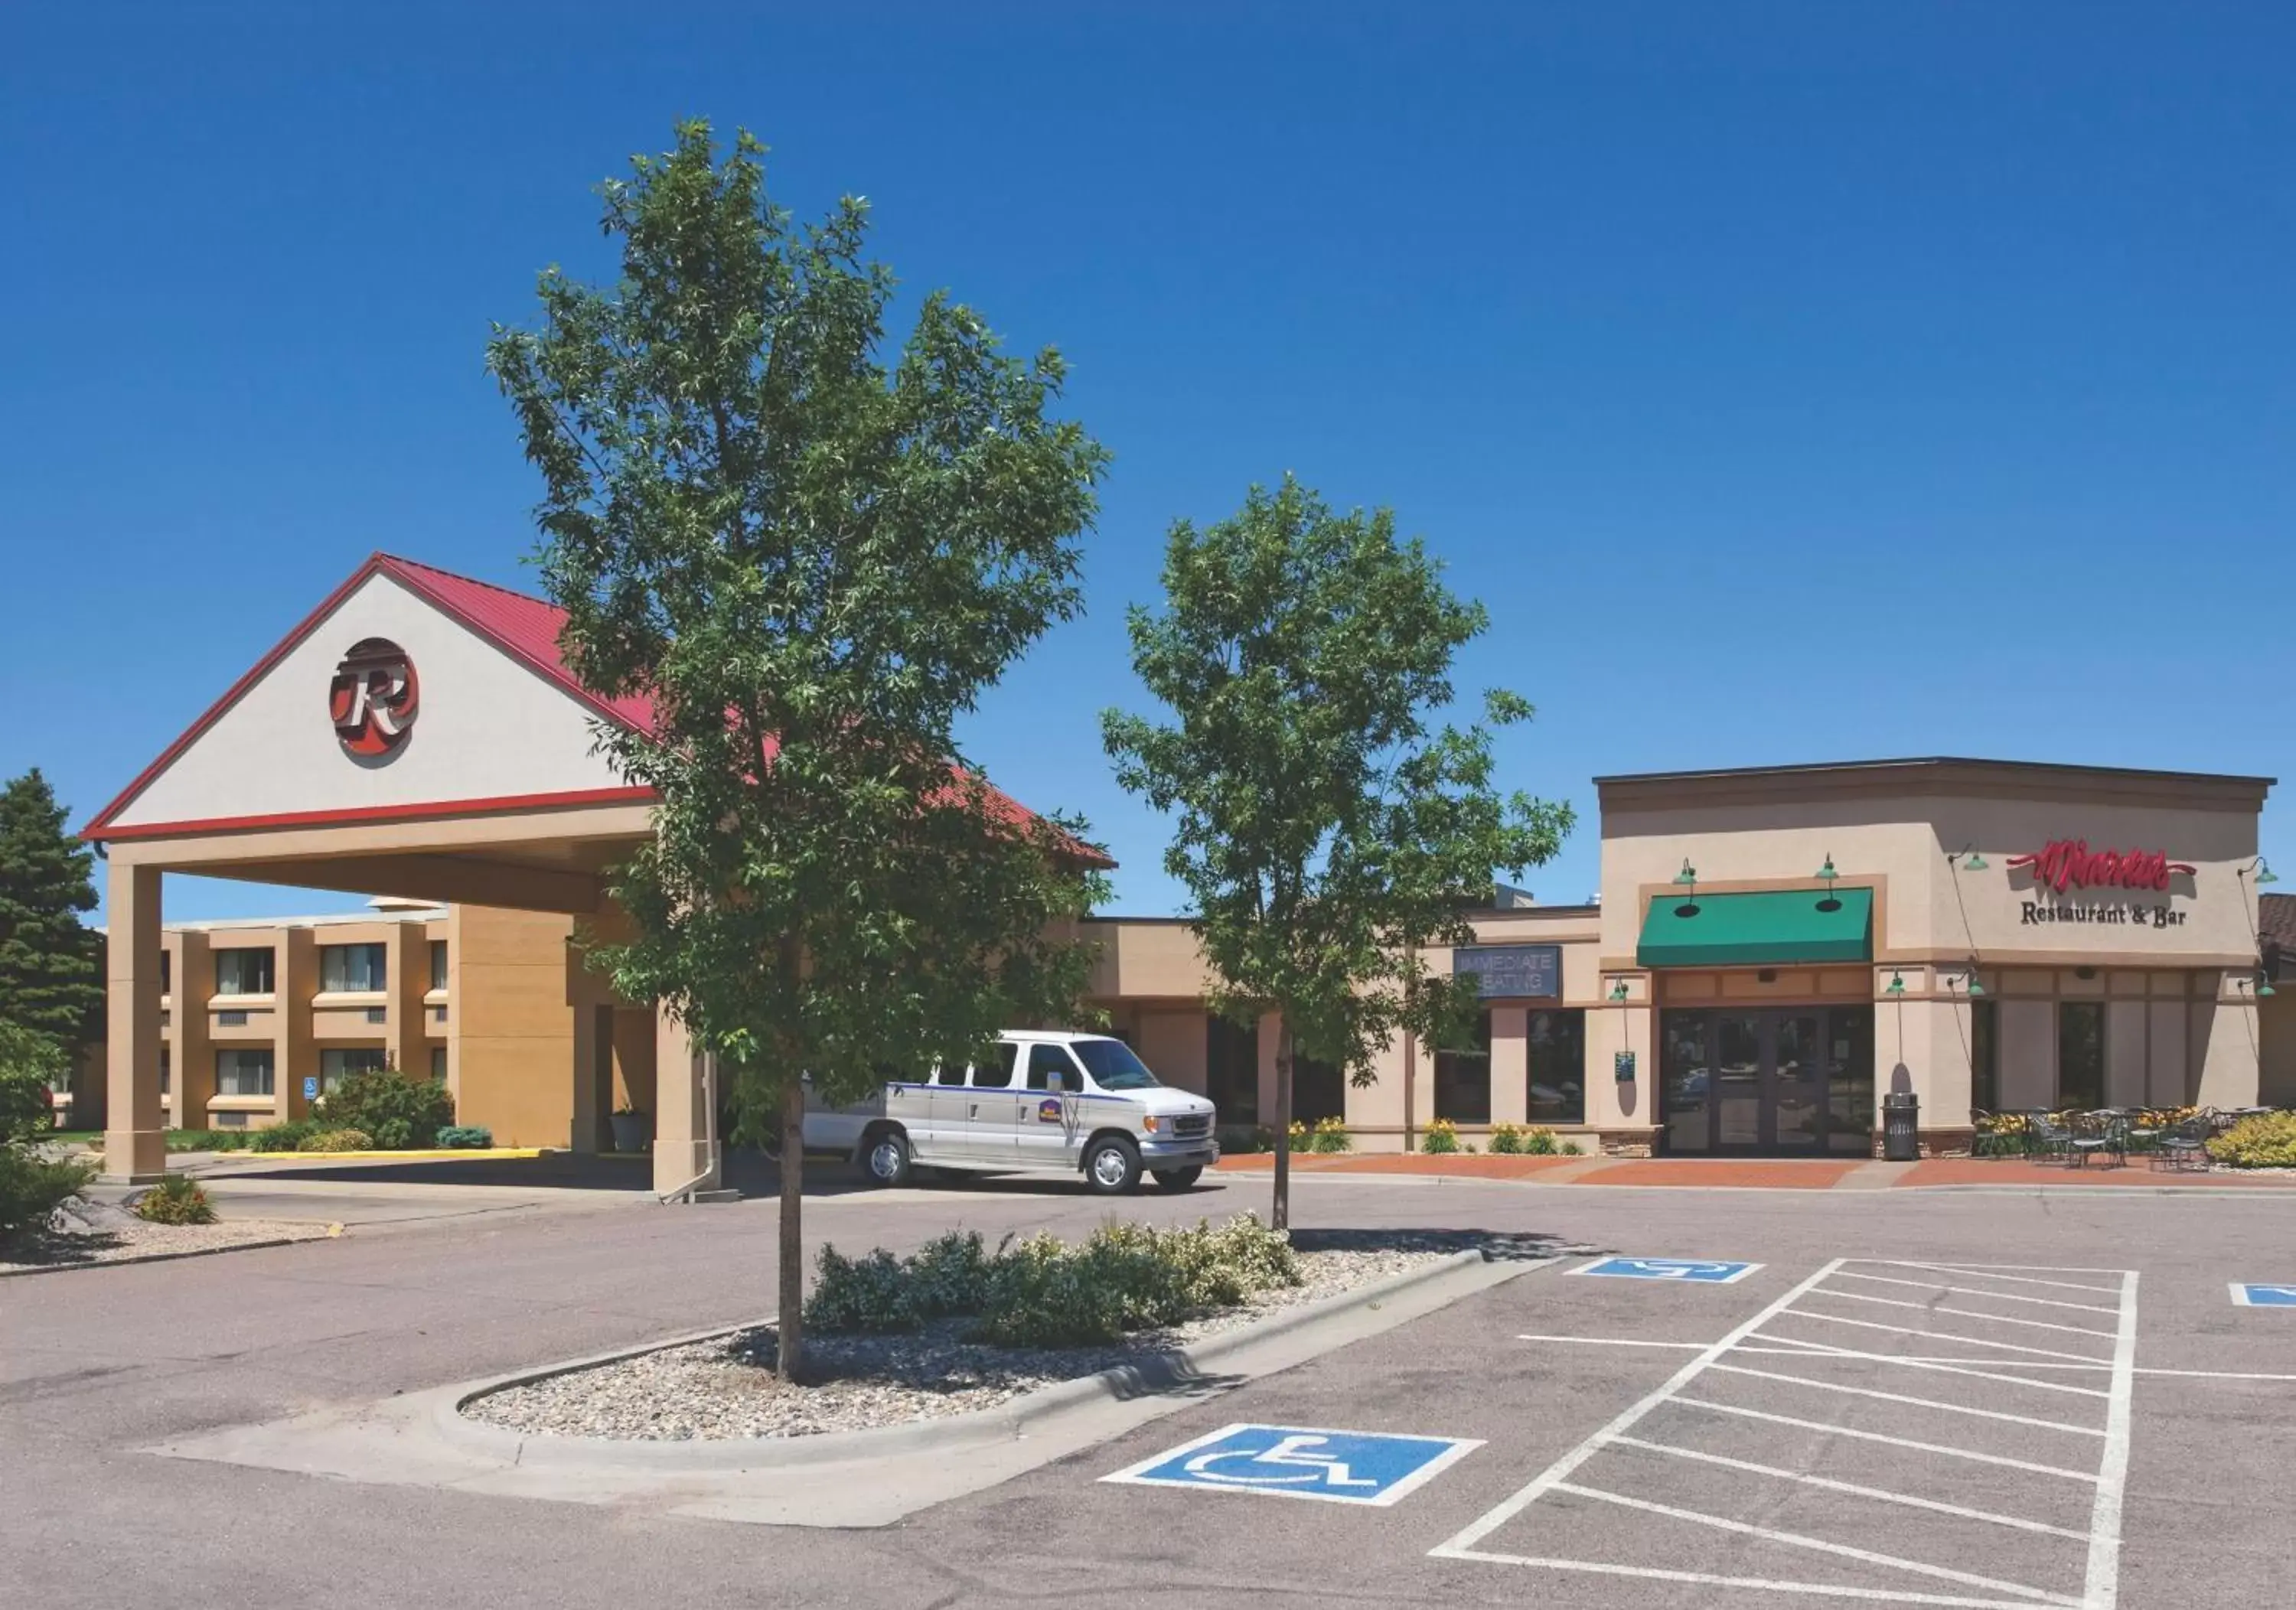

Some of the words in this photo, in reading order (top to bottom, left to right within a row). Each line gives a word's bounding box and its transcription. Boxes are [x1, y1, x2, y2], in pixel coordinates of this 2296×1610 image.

[2021, 901, 2126, 925] Restaurant
[2131, 904, 2147, 924] &
[2154, 904, 2187, 928] Bar
[1475, 973, 1543, 992] EATING
